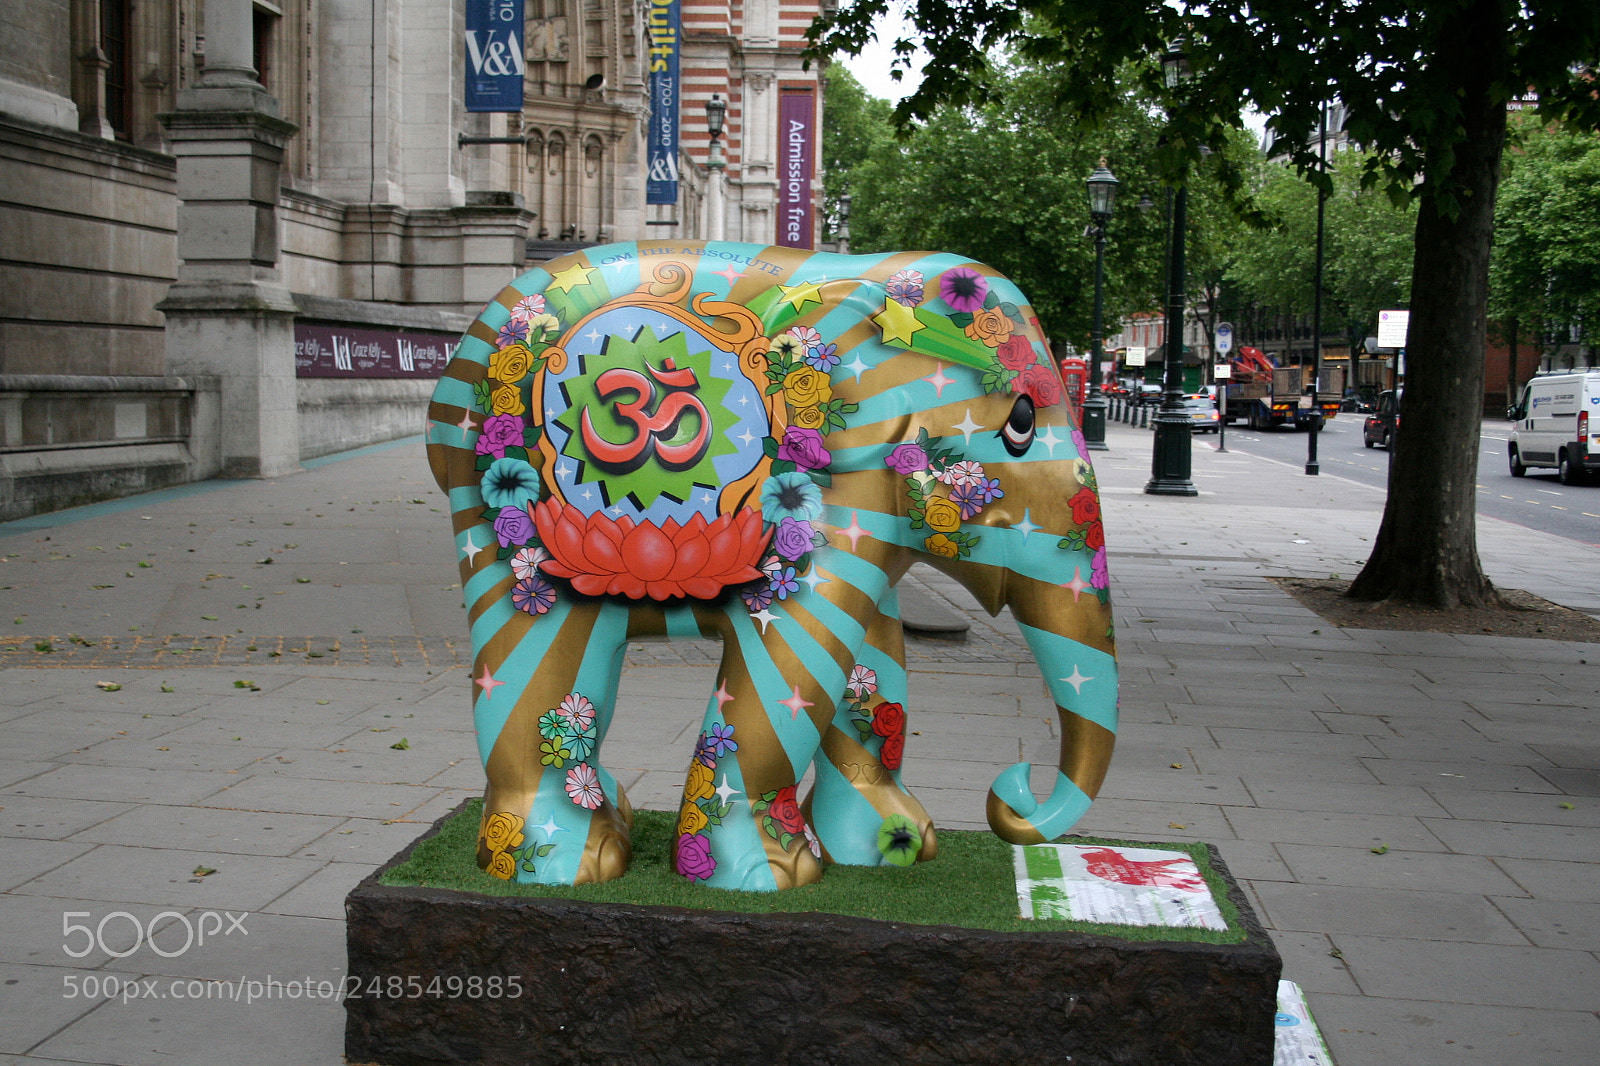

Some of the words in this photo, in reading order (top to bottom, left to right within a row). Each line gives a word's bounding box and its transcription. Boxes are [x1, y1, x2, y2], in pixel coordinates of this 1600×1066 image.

[465, 29, 525, 76] V&A
[788, 120, 805, 203] Admission
[787, 207, 805, 242] free
[600, 252, 633, 266] OM
[637, 247, 676, 257] THE
[679, 247, 784, 276] ABSOLUTE
[332, 335, 355, 371] V&A
[368, 341, 381, 363] Kelly
[397, 338, 415, 372] V&A
